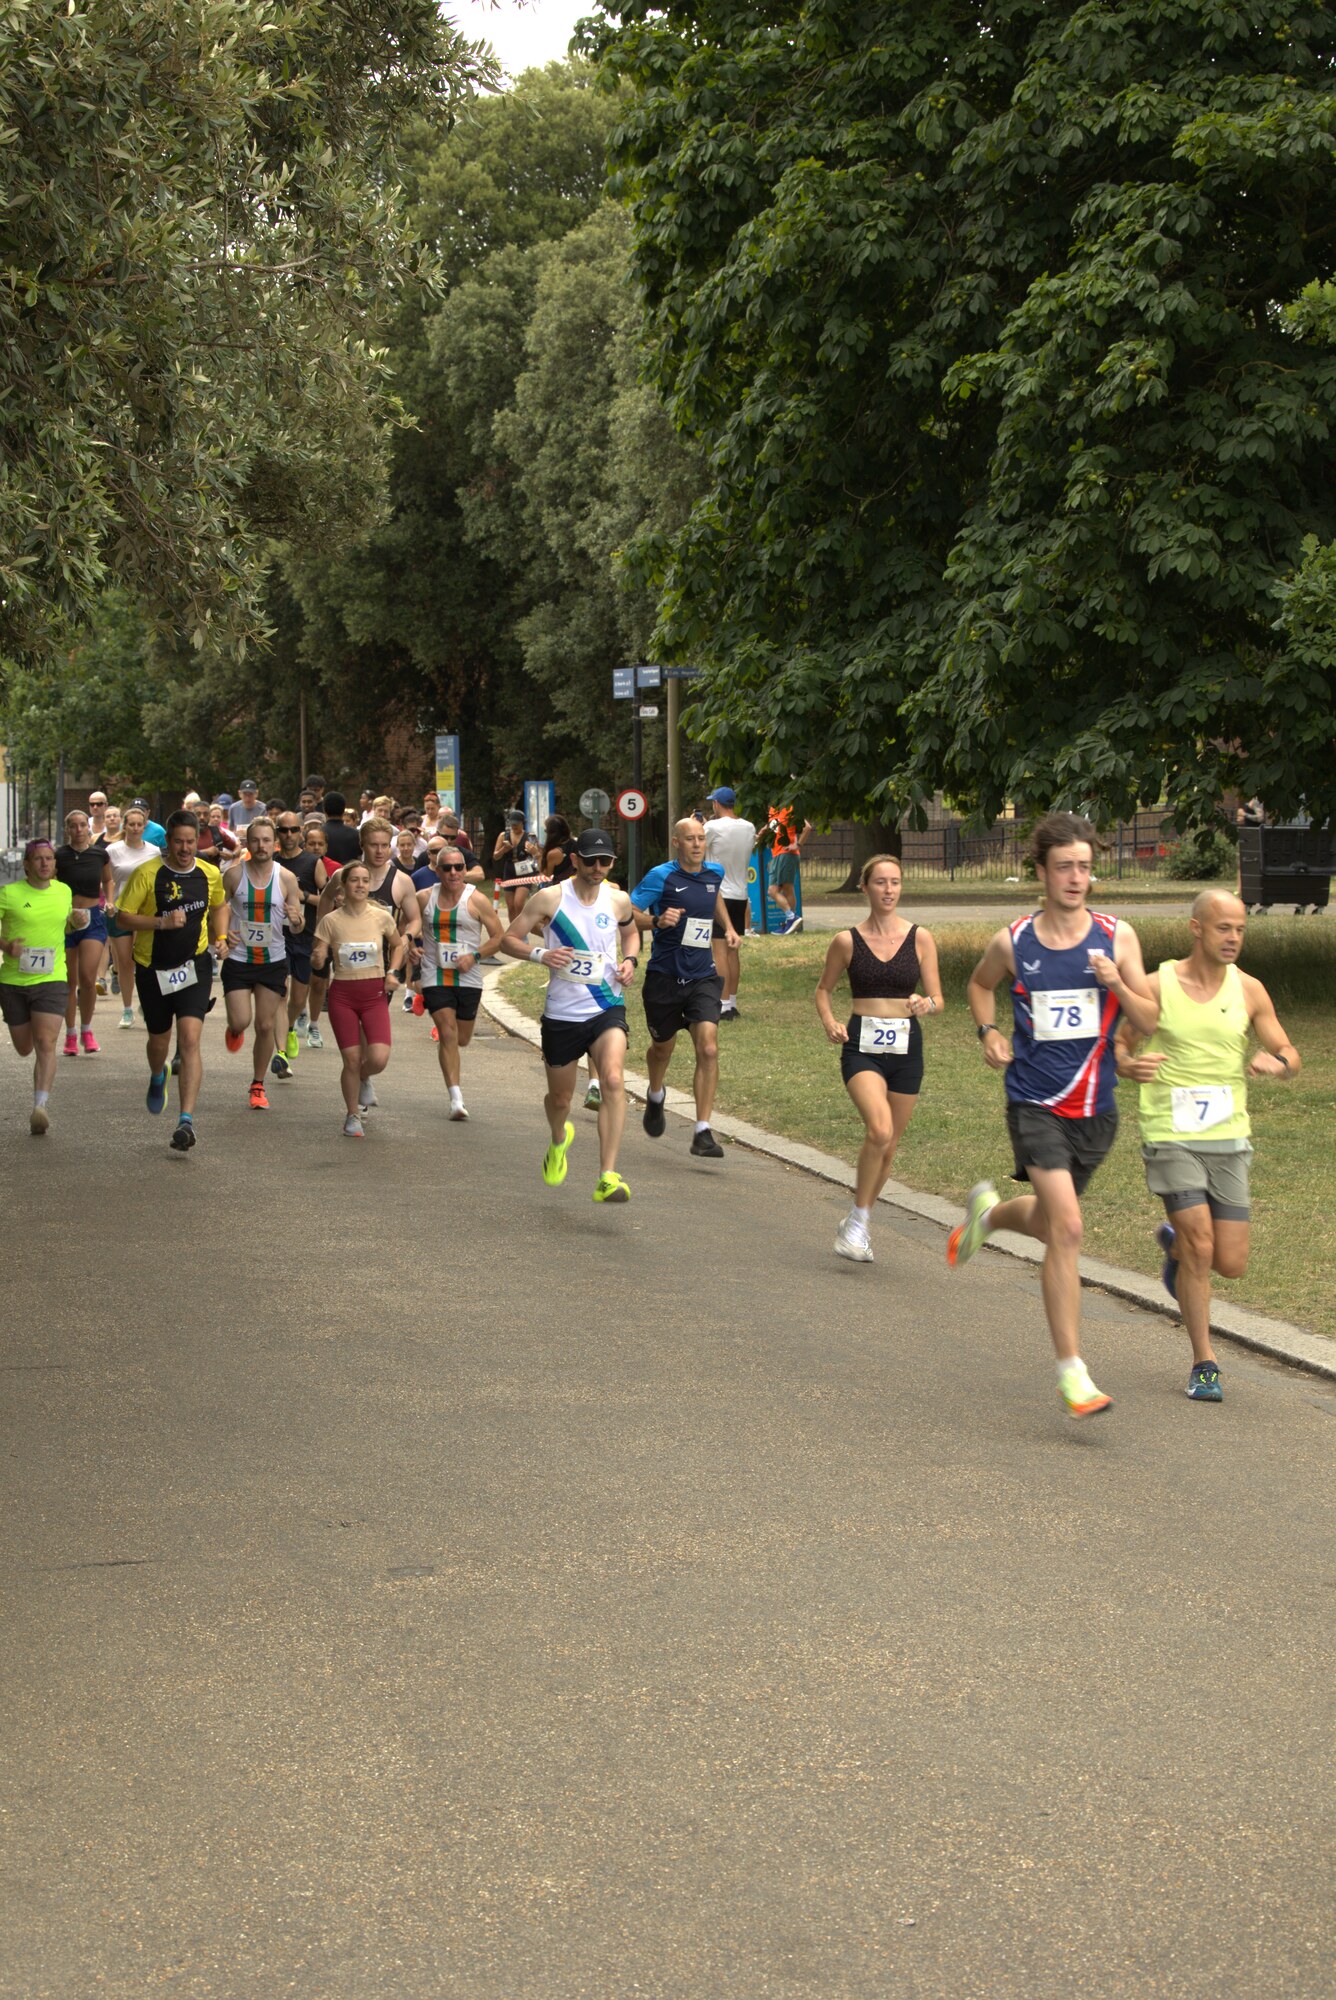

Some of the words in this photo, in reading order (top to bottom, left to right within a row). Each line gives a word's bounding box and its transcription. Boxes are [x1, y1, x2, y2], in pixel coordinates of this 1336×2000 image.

[628, 798, 637, 811] 5
[248, 929, 265, 942] 75
[694, 927, 710, 942] 74
[30, 955, 46, 968] 71
[348, 950, 367, 962] 49
[442, 950, 458, 963] 16
[570, 959, 593, 976] 23
[168, 970, 187, 985] 40
[1049, 1005, 1082, 1028] 78
[873, 1028, 897, 1046] 29
[1195, 1100, 1209, 1121] 7
